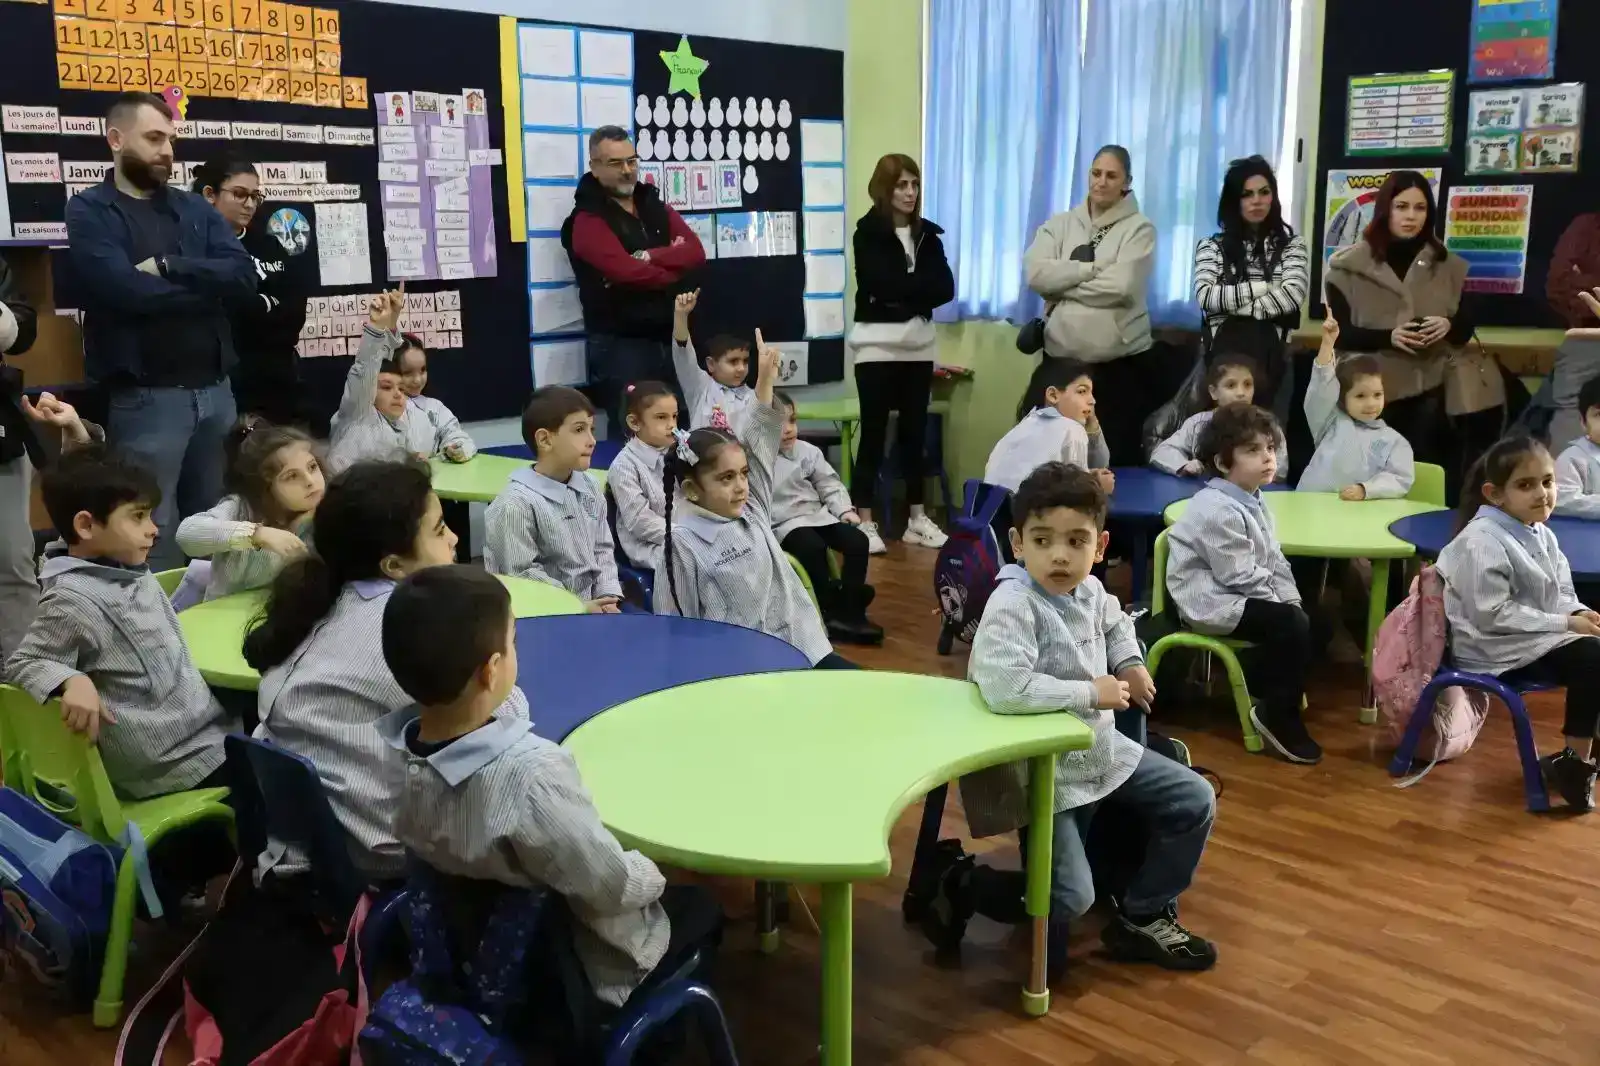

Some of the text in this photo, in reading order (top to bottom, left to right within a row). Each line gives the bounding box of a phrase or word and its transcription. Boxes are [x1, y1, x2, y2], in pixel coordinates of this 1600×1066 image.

[126, 0, 137, 14] 3
[153, 0, 166, 16] 4
[184, 1, 195, 19] 5
[212, 5, 223, 22] 6
[241, 7, 252, 24] 7
[268, 10, 279, 27] 8
[294, 14, 305, 31] 9
[316, 17, 338, 35] 10
[59, 26, 339, 68] 11 12 13 14 15 16 17 18 19 20
[60, 63, 366, 103] 21 22 23 24 25 26 27 28 29 30 31
[1542, 94, 1567, 102] Spring
[8, 110, 22, 118] Les
[23, 111, 44, 119] jours
[65, 121, 96, 131] Lundi
[201, 126, 226, 136] Jeudi
[235, 127, 279, 137] Vendredi
[328, 132, 371, 142] Dimanche
[10, 158, 23, 166] Les
[24, 158, 45, 166] mois
[300, 168, 322, 179] Juin
[697, 173, 709, 191] L
[724, 171, 736, 187] R
[265, 188, 312, 197] Novembre
[314, 187, 358, 197] Décembre
[1460, 195, 1519, 207] SUNDAY
[1456, 211, 1520, 222] MONDAY
[1454, 224, 1520, 236] TUESDAY
[319, 303, 326, 313] P
[332, 301, 342, 313] Q
[347, 301, 354, 311] R
[361, 300, 367, 311] S
[410, 298, 422, 309] W
[425, 297, 432, 307] X
[439, 296, 445, 306] Y
[451, 295, 458, 305] Z
[322, 324, 328, 335] p
[336, 322, 343, 333] q
[351, 322, 355, 332] r
[400, 321, 407, 329] v
[412, 320, 422, 328] w
[427, 319, 433, 328] x
[440, 318, 446, 329] y
[452, 318, 457, 326] z
